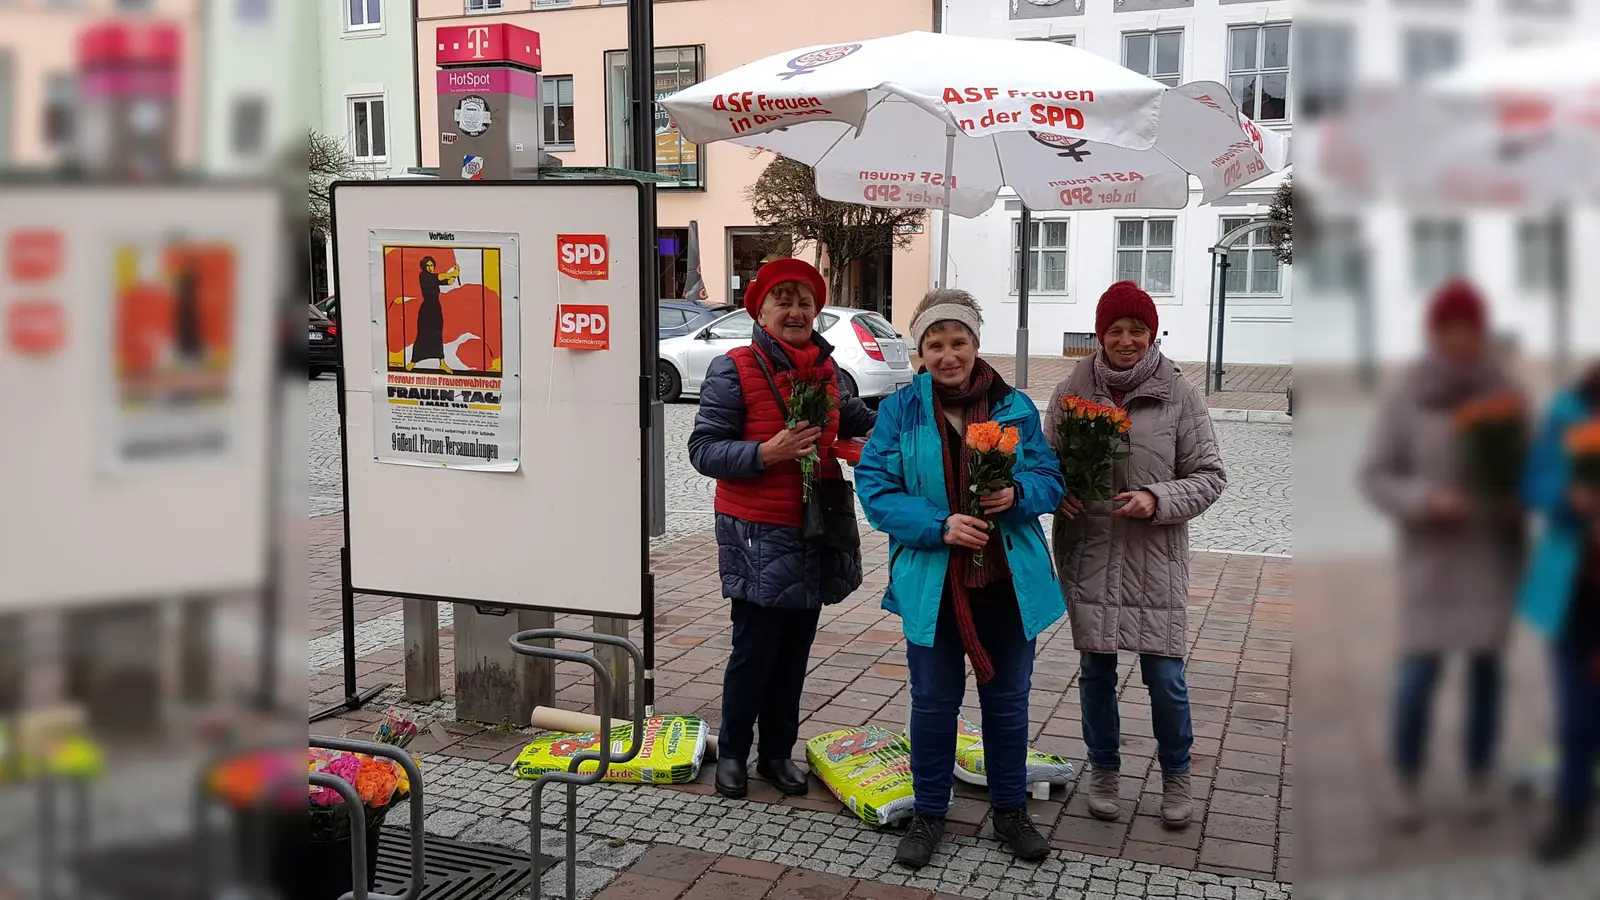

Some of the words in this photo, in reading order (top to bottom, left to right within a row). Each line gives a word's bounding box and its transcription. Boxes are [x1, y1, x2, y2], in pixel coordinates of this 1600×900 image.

[468, 27, 489, 58] T
[449, 72, 490, 87] HotSpot
[712, 91, 753, 113] ASF
[757, 94, 823, 113] Frauen
[943, 87, 999, 105] ASF
[1007, 89, 1094, 102] Frauen
[729, 117, 752, 134] in
[959, 117, 975, 131] n
[980, 109, 1022, 128] der
[1030, 104, 1085, 130] SPD
[428, 232, 455, 241] Vorwärts
[561, 243, 606, 265] SPD
[562, 265, 607, 276] Sozialdemokraten
[561, 312, 607, 335] SPD
[559, 336, 607, 346] Sozialdemokraten
[415, 376, 426, 385] mit
[427, 376, 438, 386] dem
[438, 377, 502, 390] Frauenwahlrecht
[420, 434, 499, 462] Frauen-Versammlungen
[640, 717, 664, 759] Blumen
[609, 769, 634, 778] Erde
